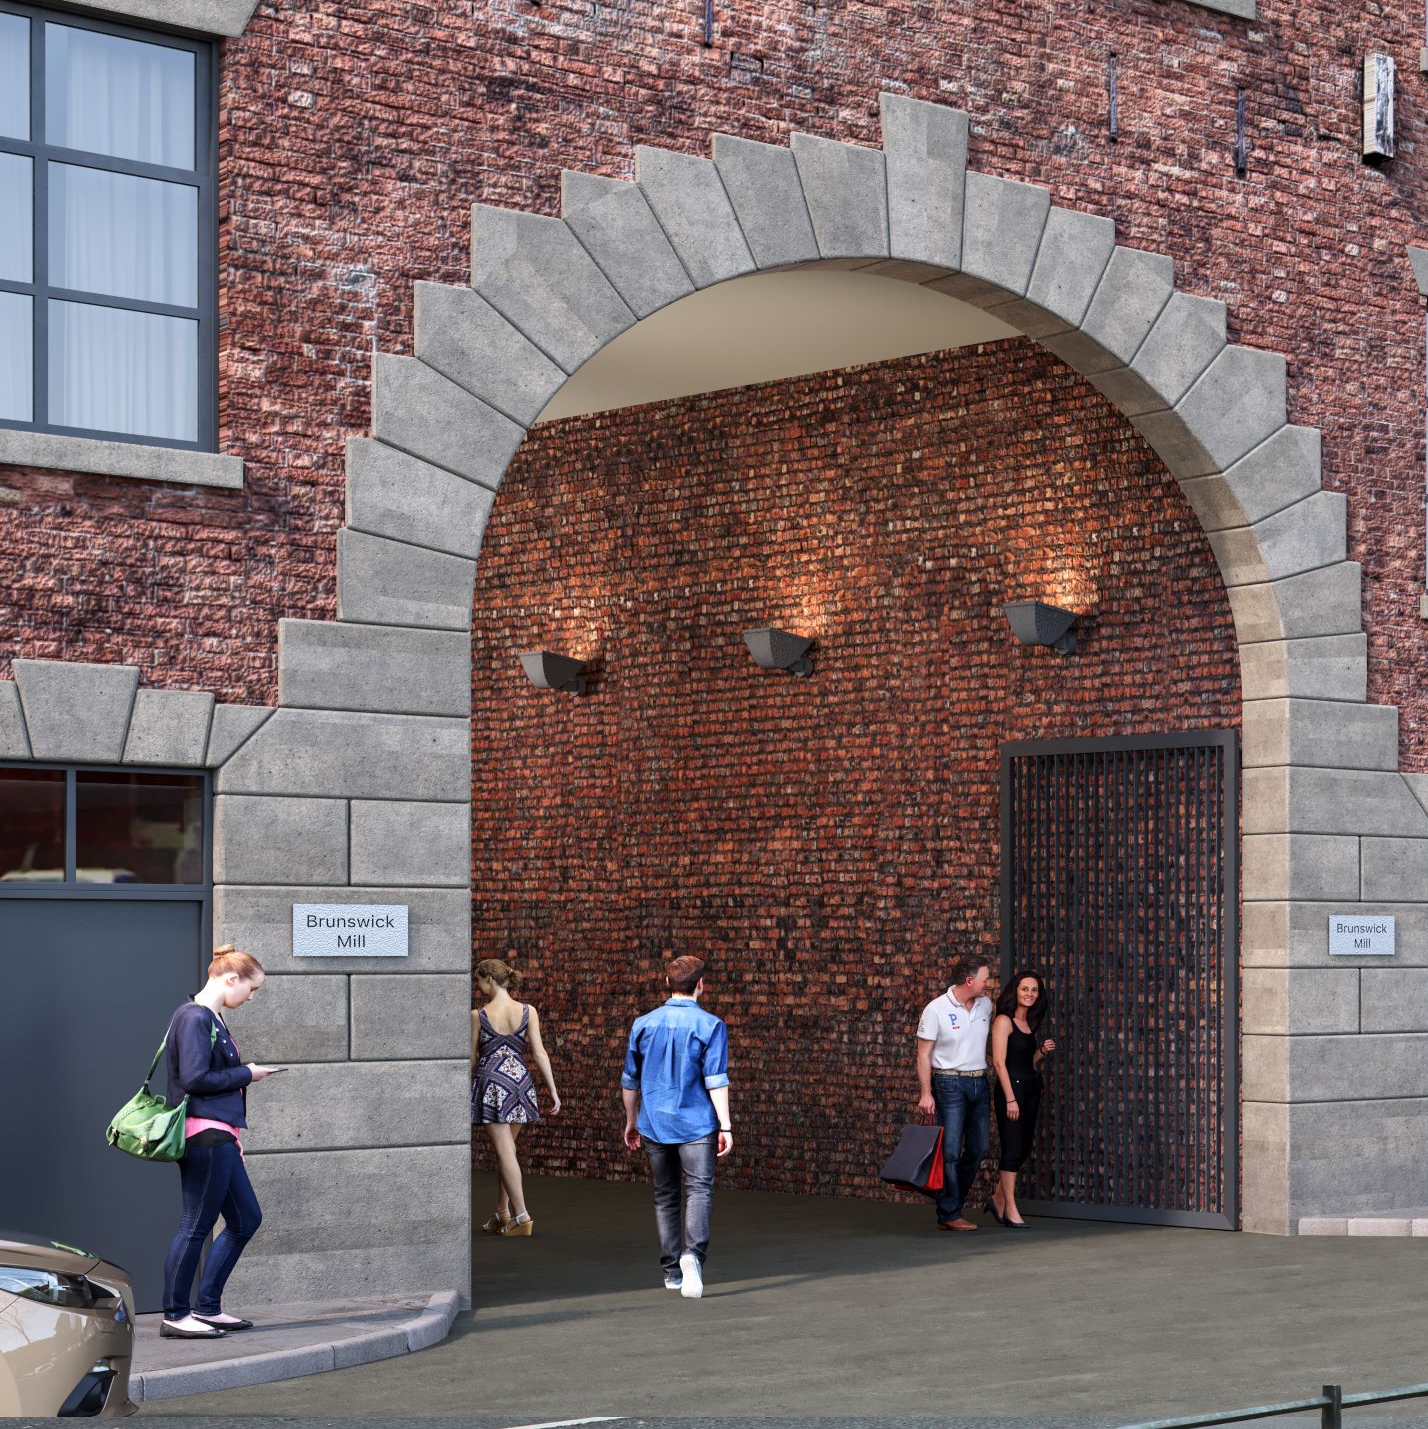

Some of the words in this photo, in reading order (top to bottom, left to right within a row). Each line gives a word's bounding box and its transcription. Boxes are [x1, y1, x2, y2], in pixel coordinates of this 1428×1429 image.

[306, 914, 395, 928] Brunswick
[1336, 923, 1387, 934] Brunswick
[337, 935, 366, 948] Mill
[1354, 938, 1371, 949] Mill
